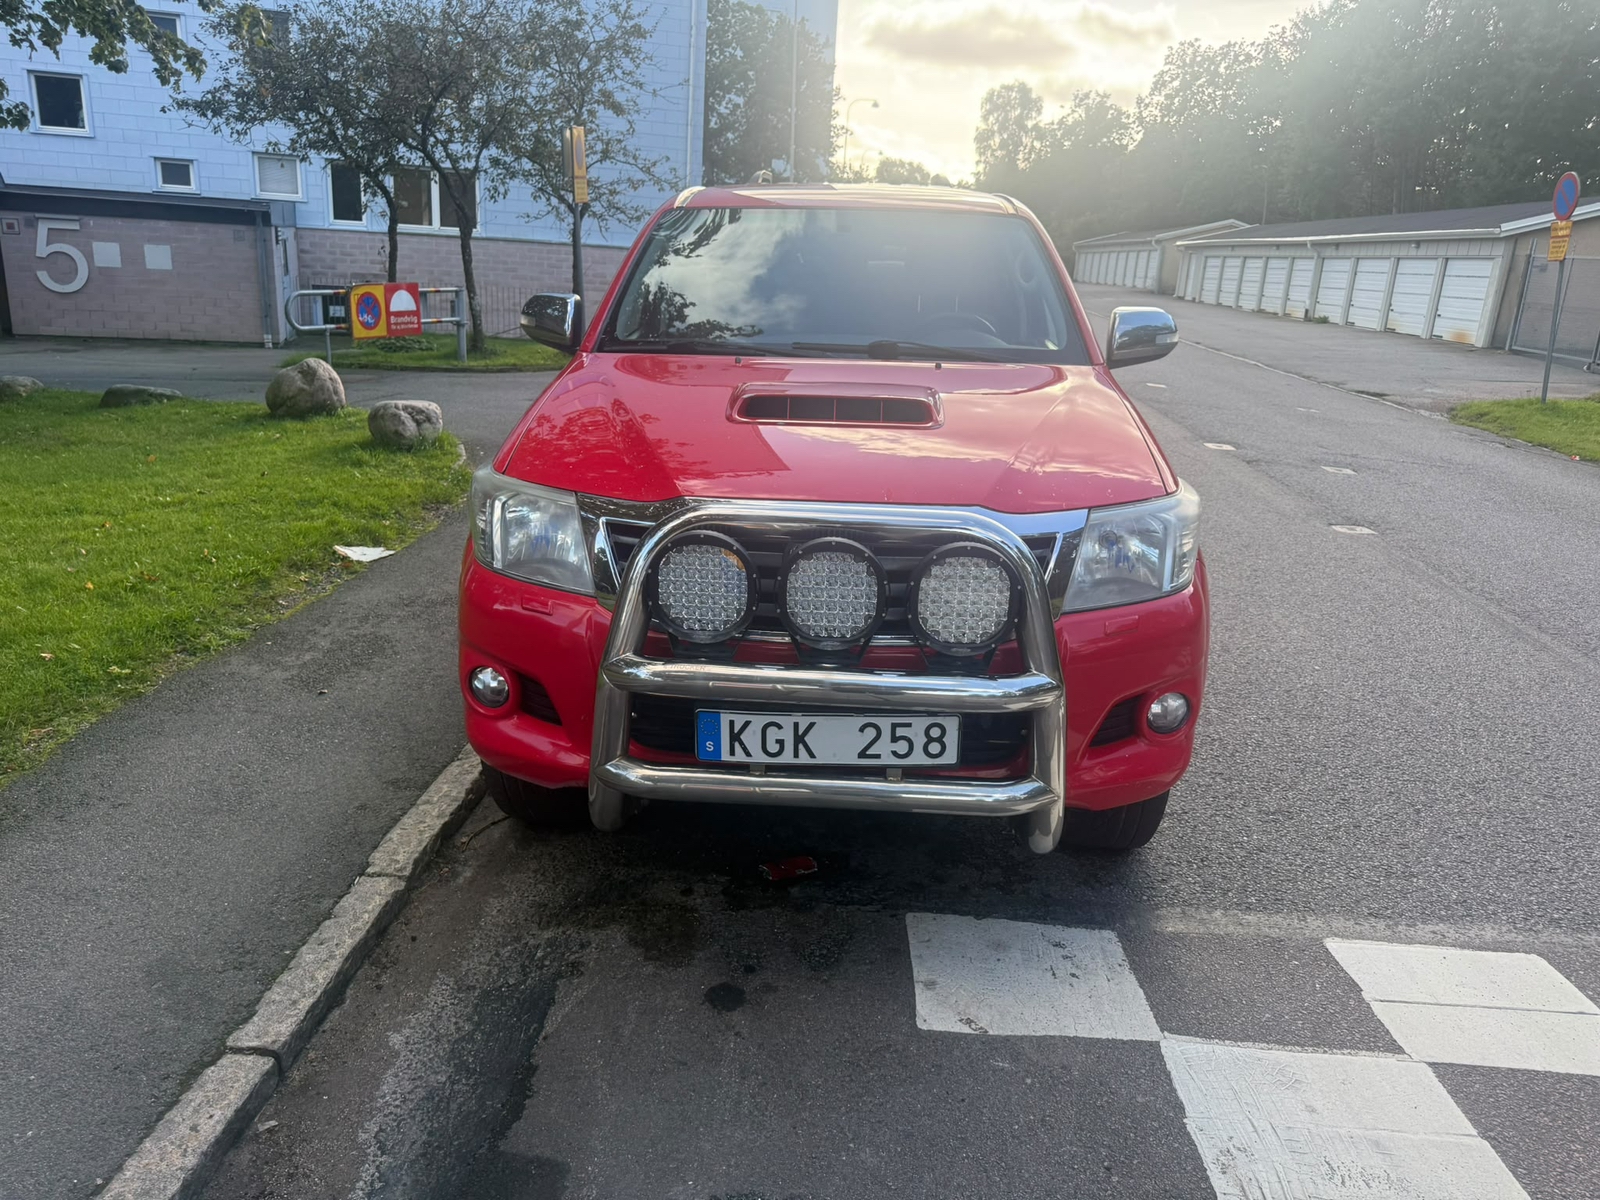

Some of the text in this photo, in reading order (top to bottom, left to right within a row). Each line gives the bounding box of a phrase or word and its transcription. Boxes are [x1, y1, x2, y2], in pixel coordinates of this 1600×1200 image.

[35, 215, 89, 294] 5
[705, 741, 714, 752] S
[728, 719, 948, 760] KGK 258
